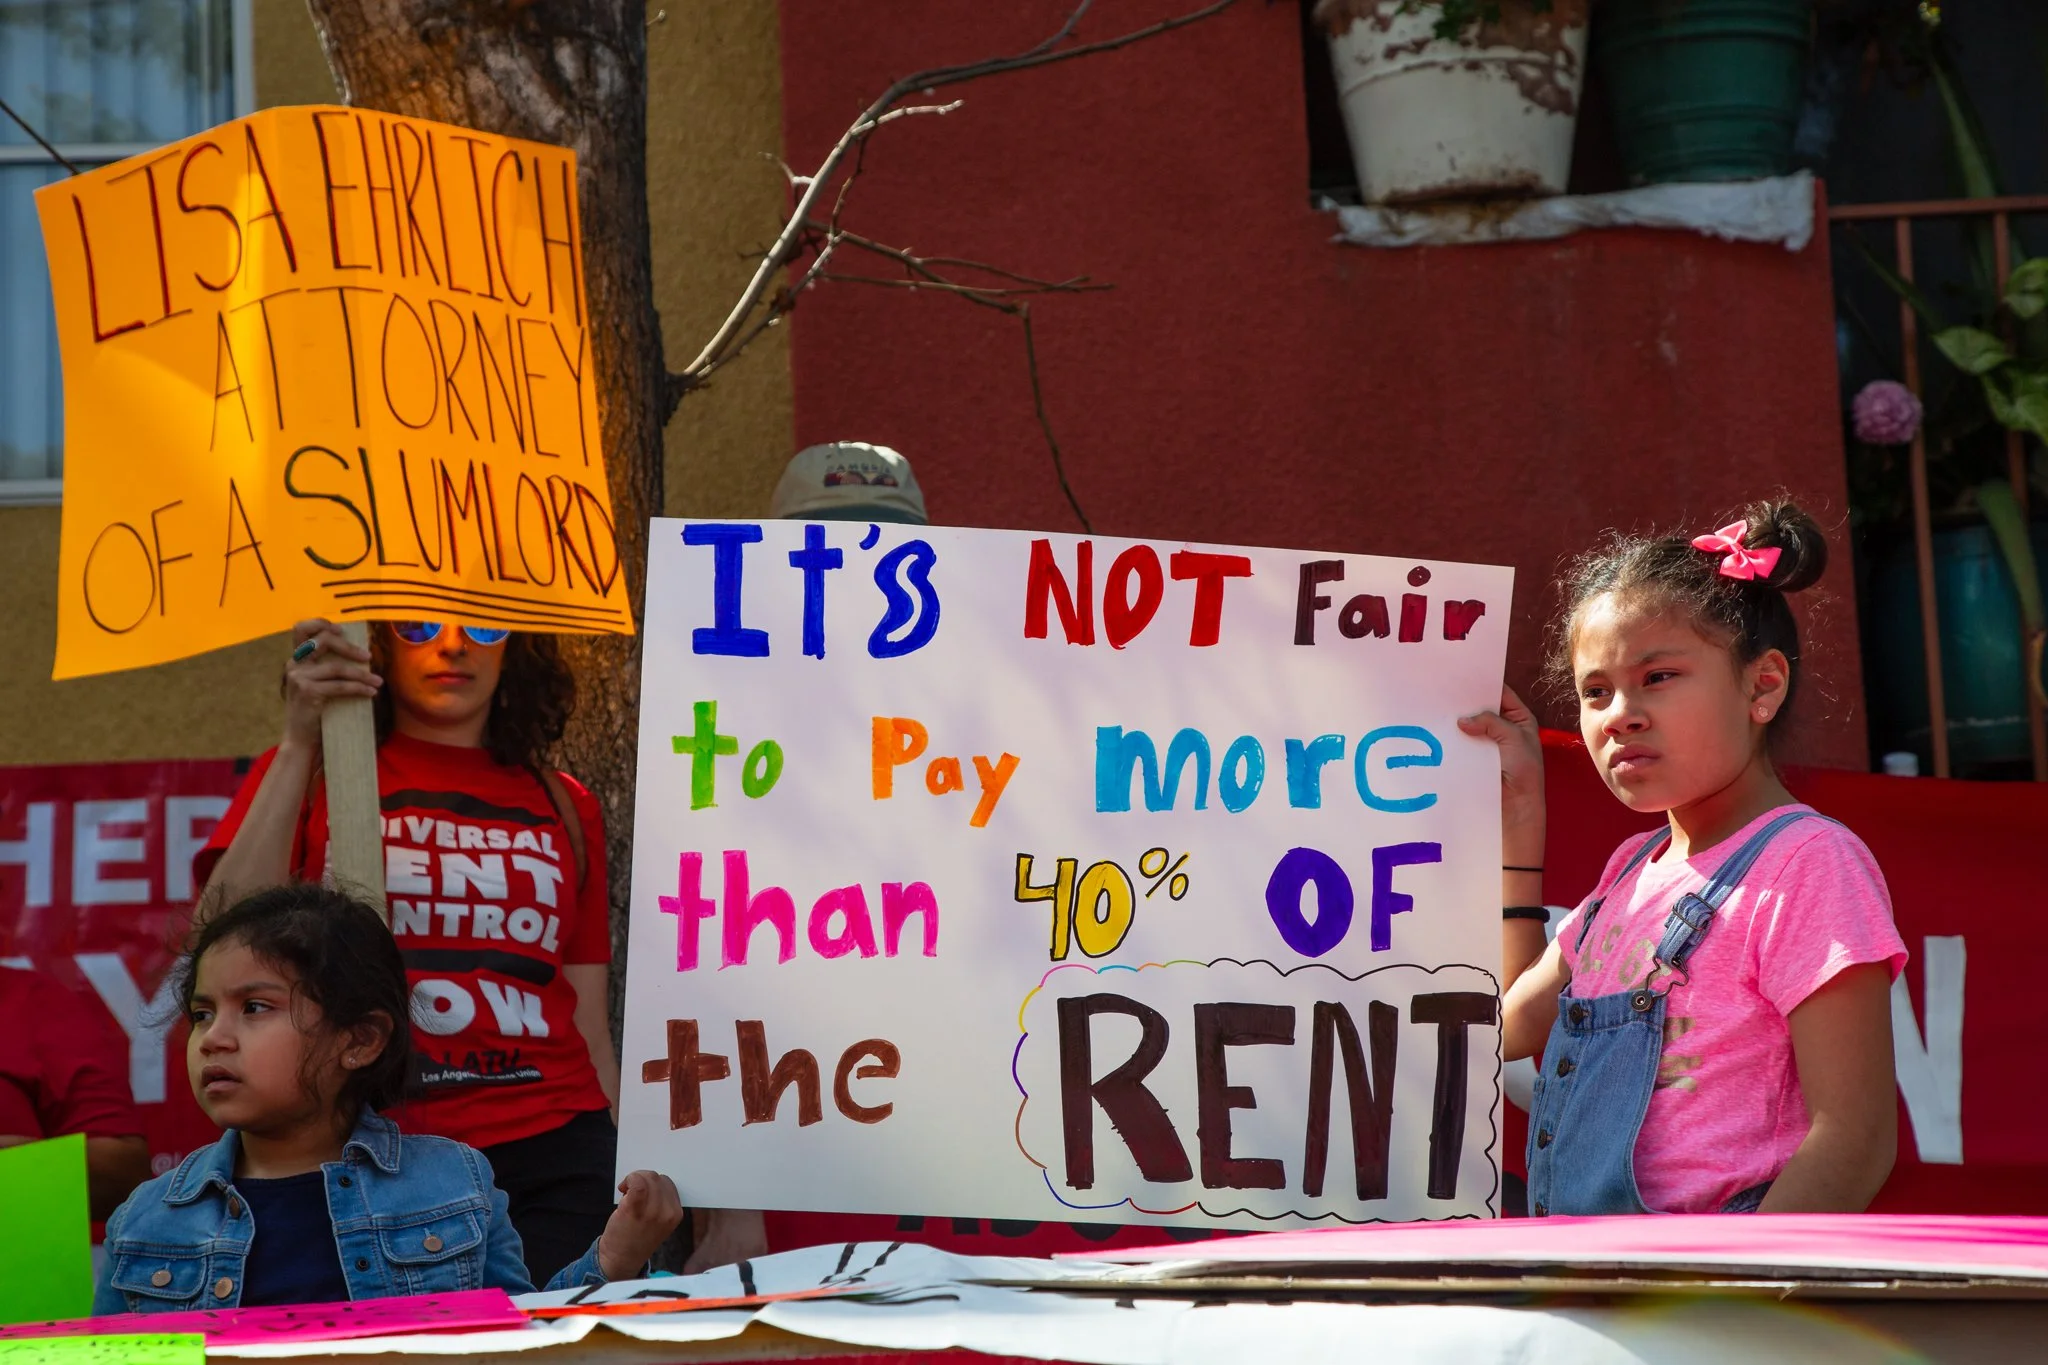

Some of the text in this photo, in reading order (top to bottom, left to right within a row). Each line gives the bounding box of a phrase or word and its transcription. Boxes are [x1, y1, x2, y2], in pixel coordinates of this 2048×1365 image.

[72, 111, 582, 343] LISA EHRLICH
[210, 286, 590, 467] ATTORNEY
[84, 445, 621, 634] OF A SLUMLORD
[681, 524, 1486, 659] It's NOT Fair
[671, 700, 1443, 828] to Pay more
[380, 815, 561, 861] IVERSAL
[385, 844, 565, 908] ENT
[392, 899, 561, 954] NTROL
[657, 849, 940, 972] than
[1014, 847, 1191, 961] 40%
[1265, 842, 1443, 958] OF
[408, 978, 550, 1038] OW
[642, 1018, 901, 1130] the
[1056, 990, 1499, 1200] RENT
